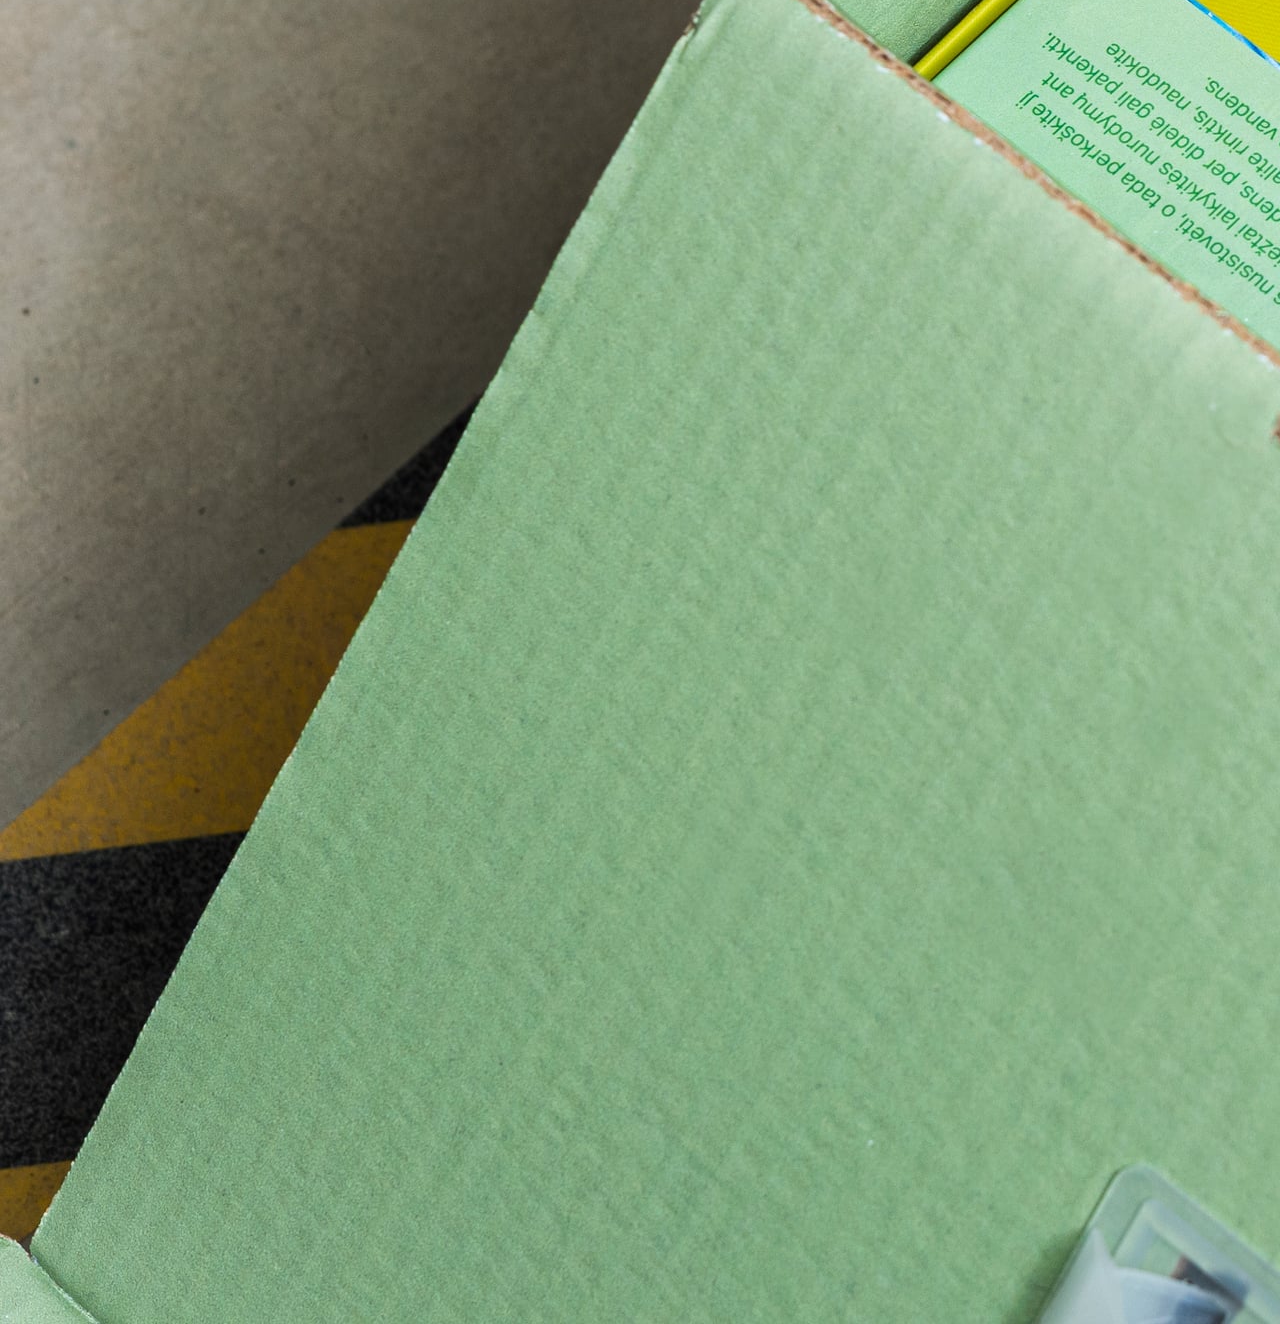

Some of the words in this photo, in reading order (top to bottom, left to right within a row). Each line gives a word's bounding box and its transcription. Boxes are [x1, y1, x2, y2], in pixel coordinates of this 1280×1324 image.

[1041, 31, 1124, 95] pakenkti.
[1014, 89, 1040, 110] jį
[1113, 90, 1155, 119] gali
[1031, 102, 1126, 176] perkoškite
[1148, 115, 1205, 160] didelė
[1119, 171, 1161, 209] tada
[1201, 158, 1241, 186] per
[1160, 203, 1176, 217] o
[1174, 212, 1275, 295] nusistovėti,
